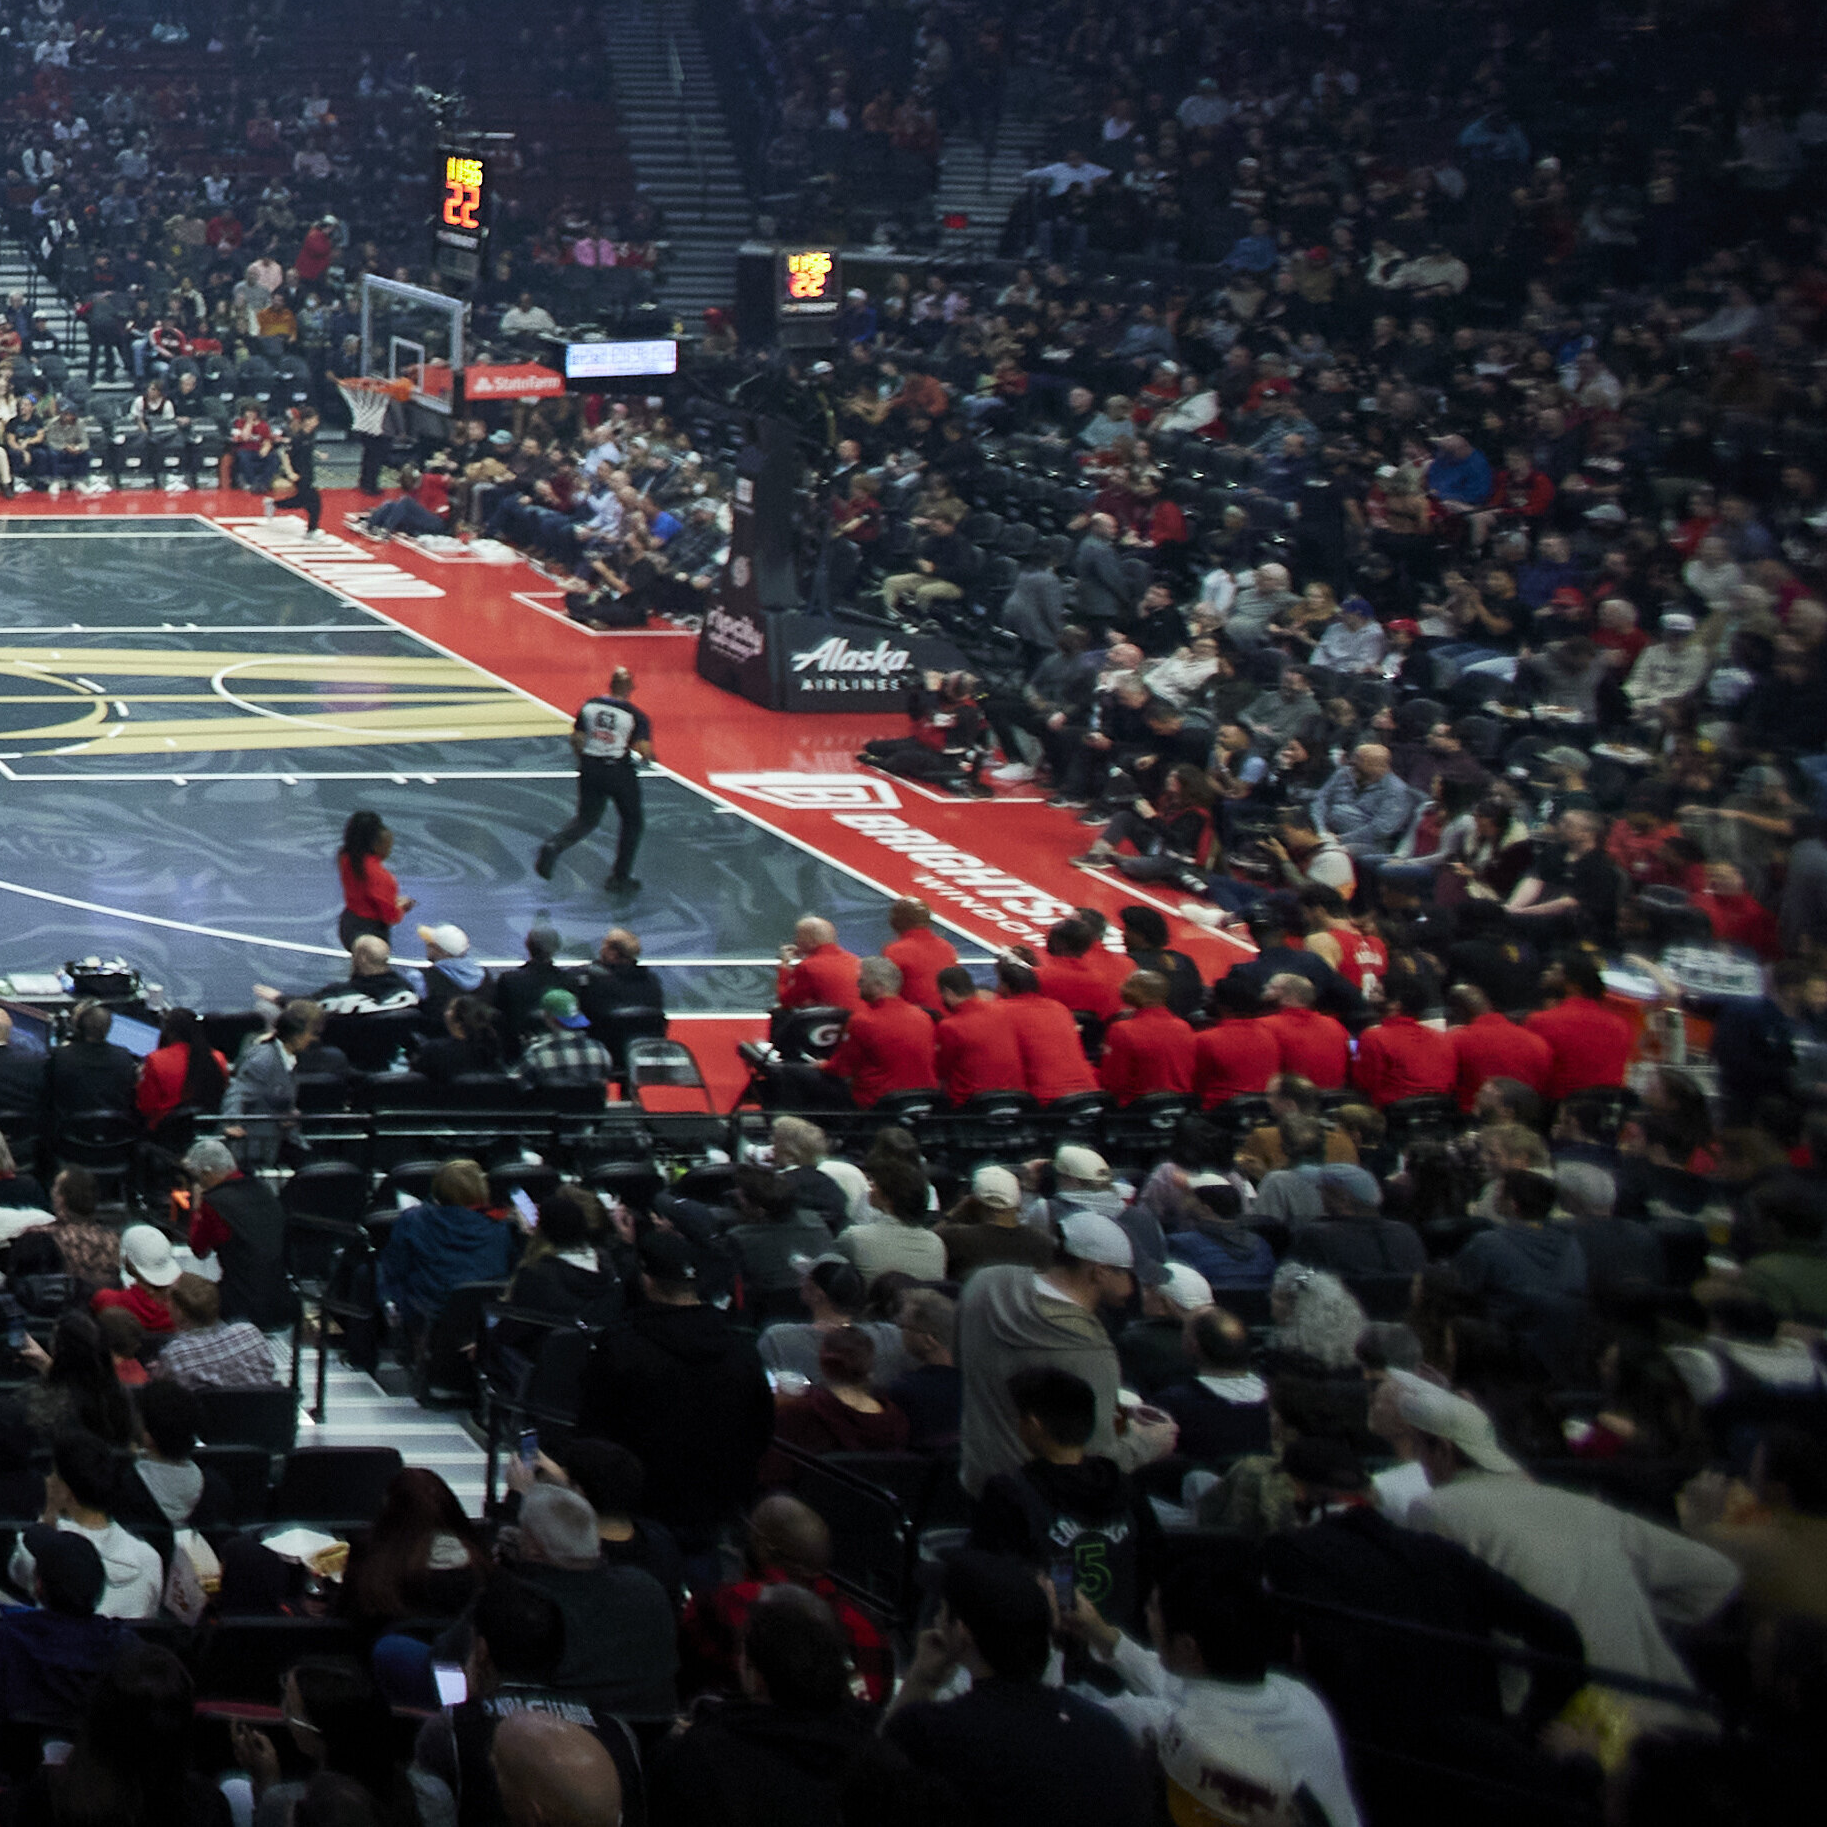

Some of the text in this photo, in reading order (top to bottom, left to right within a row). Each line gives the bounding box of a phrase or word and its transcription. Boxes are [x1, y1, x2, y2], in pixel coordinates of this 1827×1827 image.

[444, 180, 480, 229] 22
[790, 637, 910, 675] Alaska
[800, 678, 900, 692] AIRLINES
